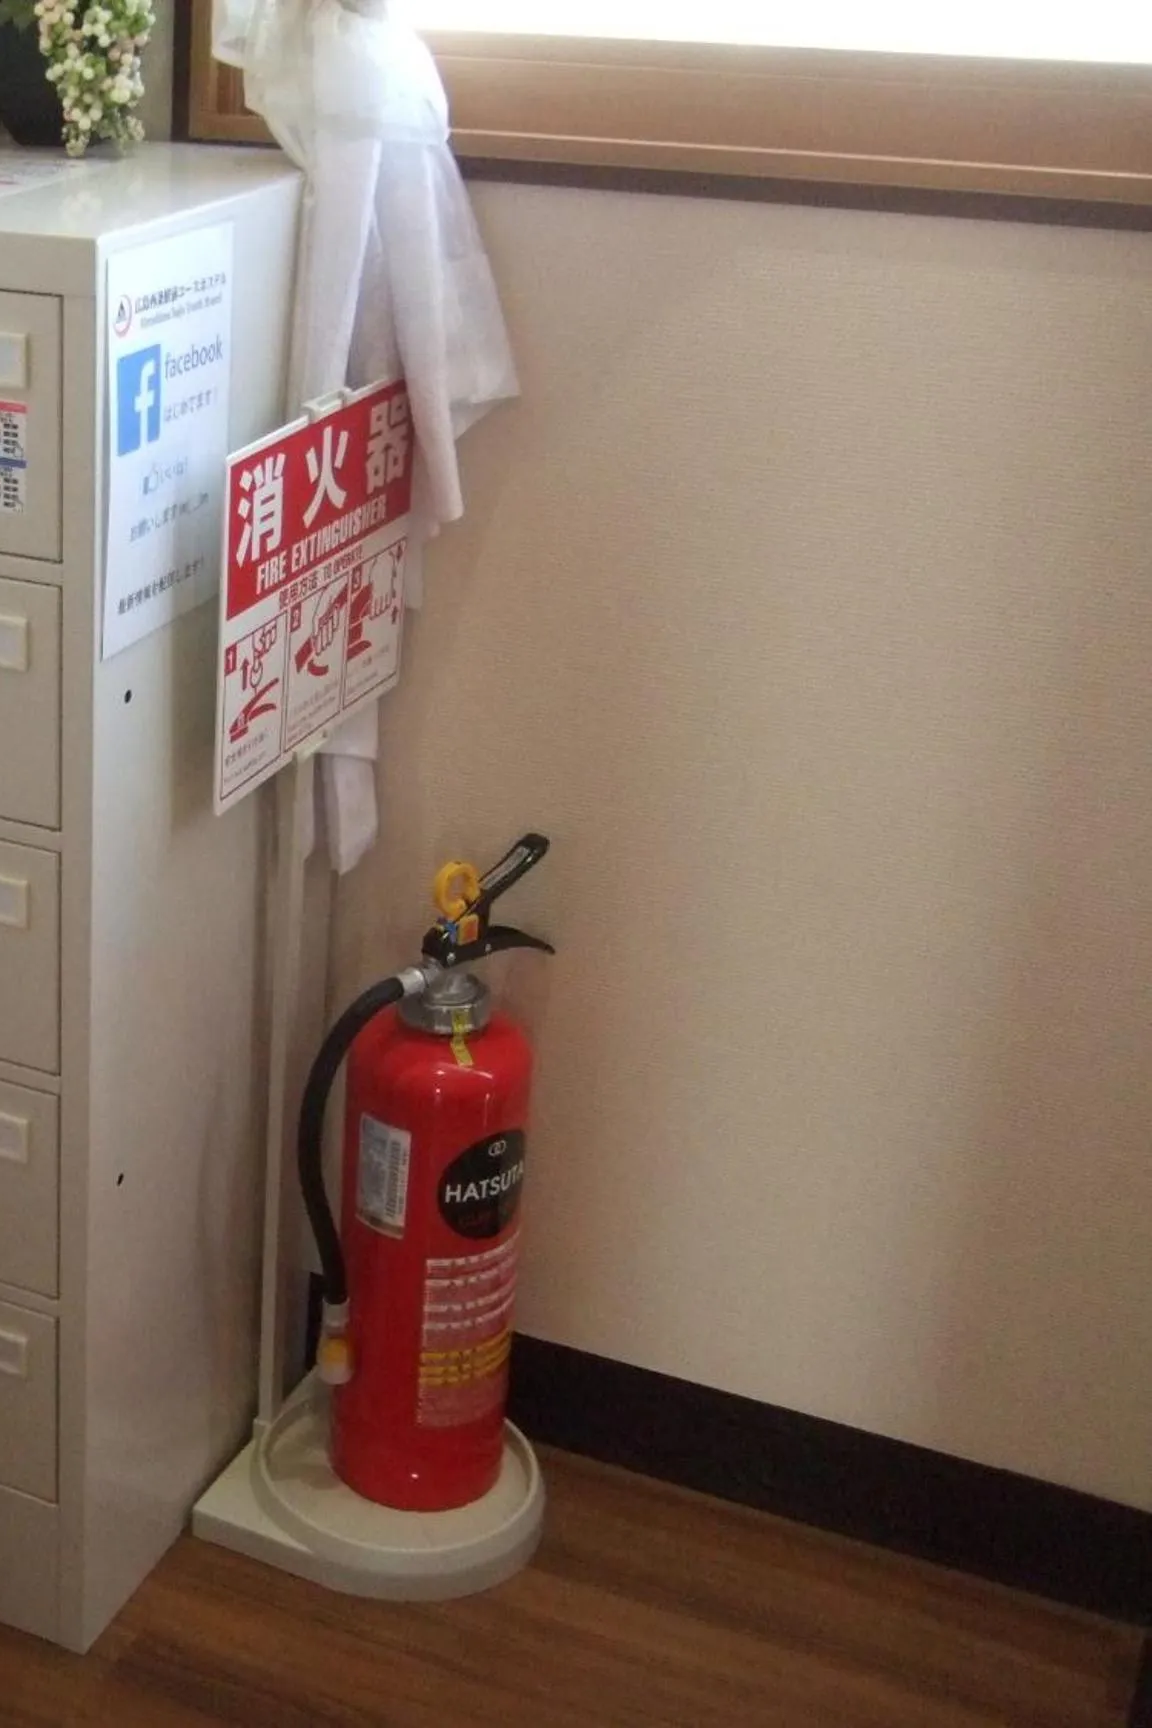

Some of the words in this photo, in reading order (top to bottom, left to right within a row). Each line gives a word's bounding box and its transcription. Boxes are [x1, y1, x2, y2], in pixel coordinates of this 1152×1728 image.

[164, 334, 223, 379] facebook
[236, 393, 408, 568] 消火器
[256, 551, 286, 595] FIRE
[291, 494, 387, 572] EXTINGUISHER
